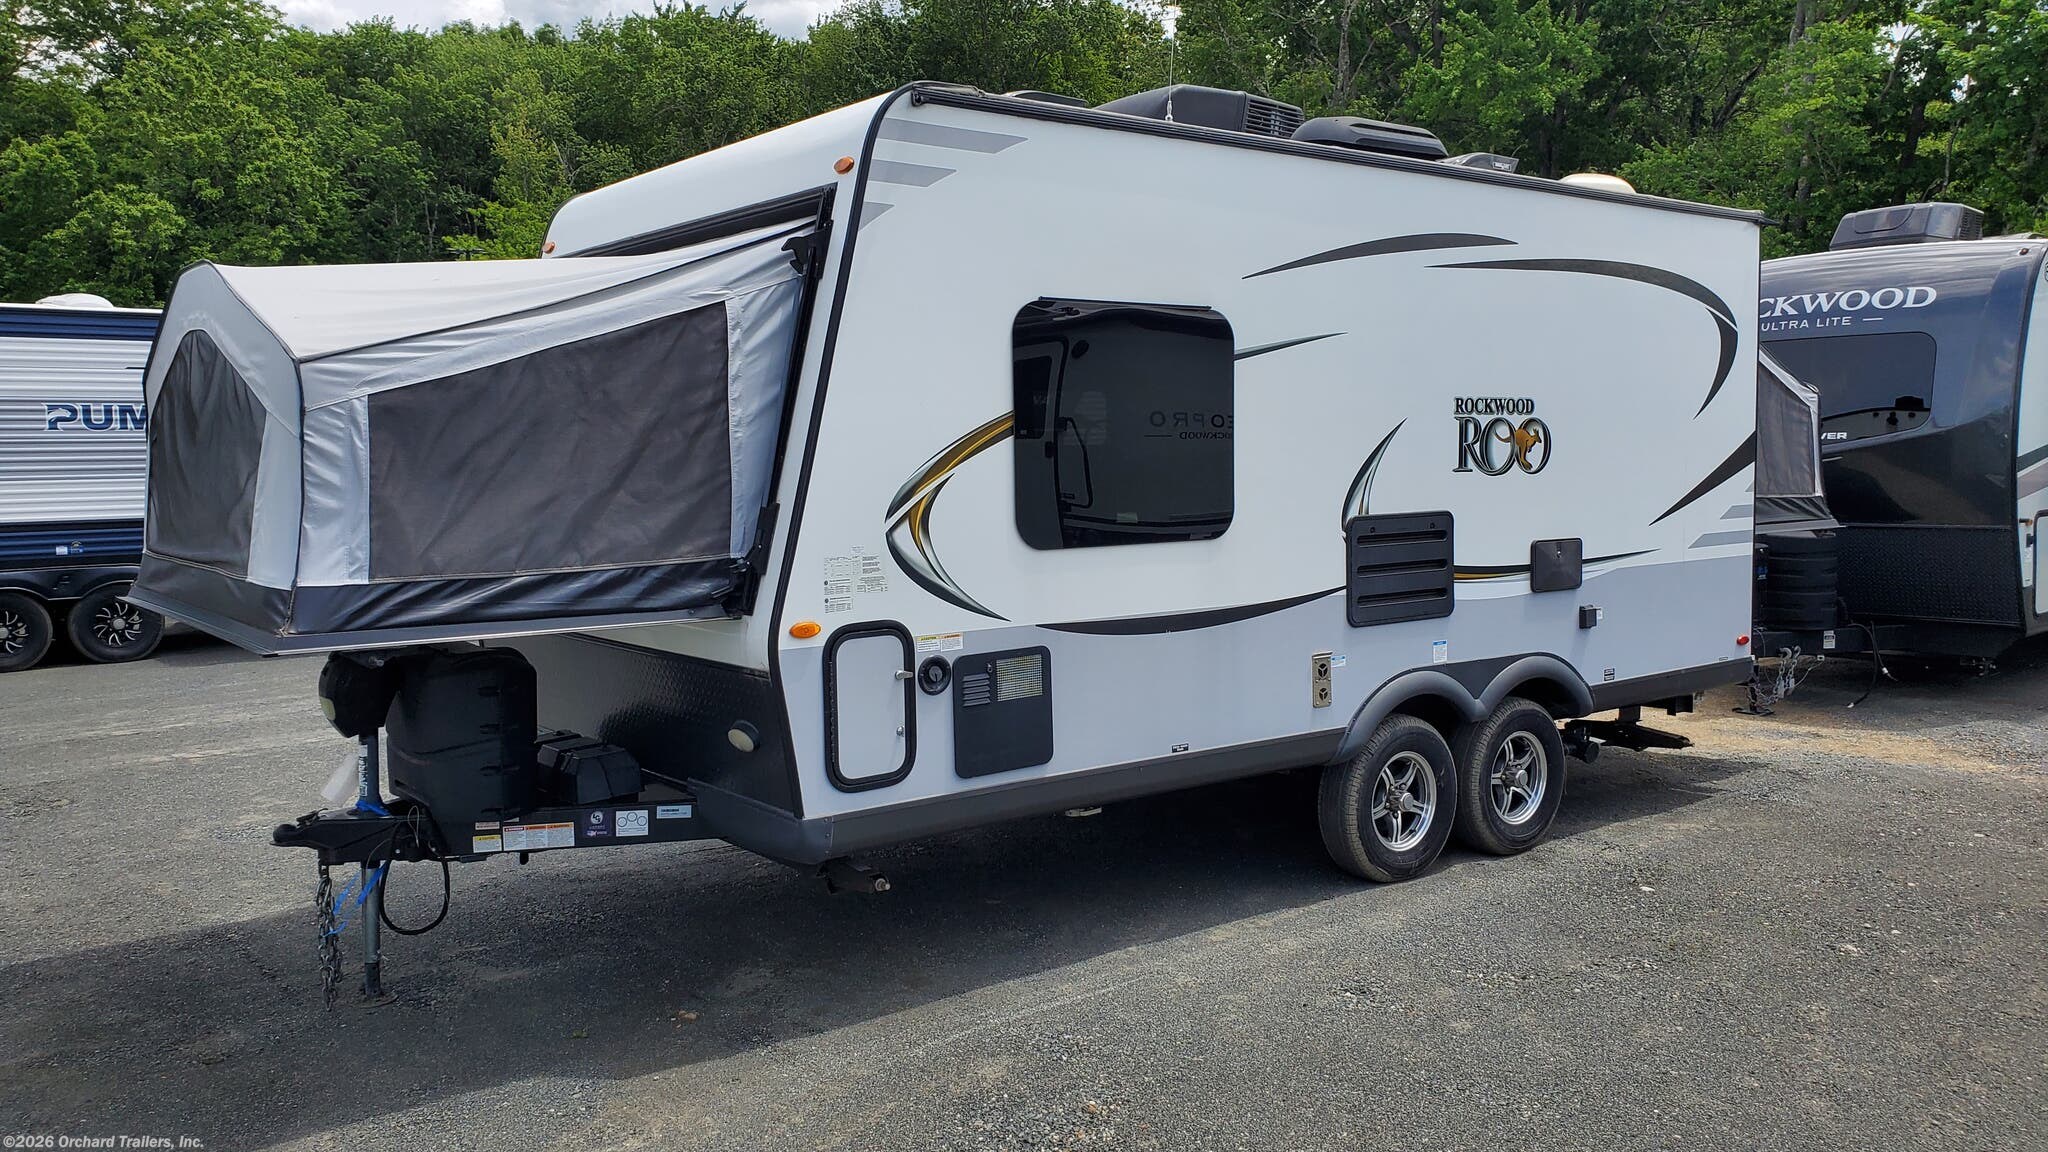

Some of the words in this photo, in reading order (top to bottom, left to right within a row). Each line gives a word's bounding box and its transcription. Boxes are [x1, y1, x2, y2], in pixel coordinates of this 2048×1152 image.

[1761, 320, 1809, 332] ULTRA
[1816, 316, 1852, 328] LITE
[1454, 397, 1535, 415] ROCKWOOD
[1452, 416, 1551, 476] ROO
